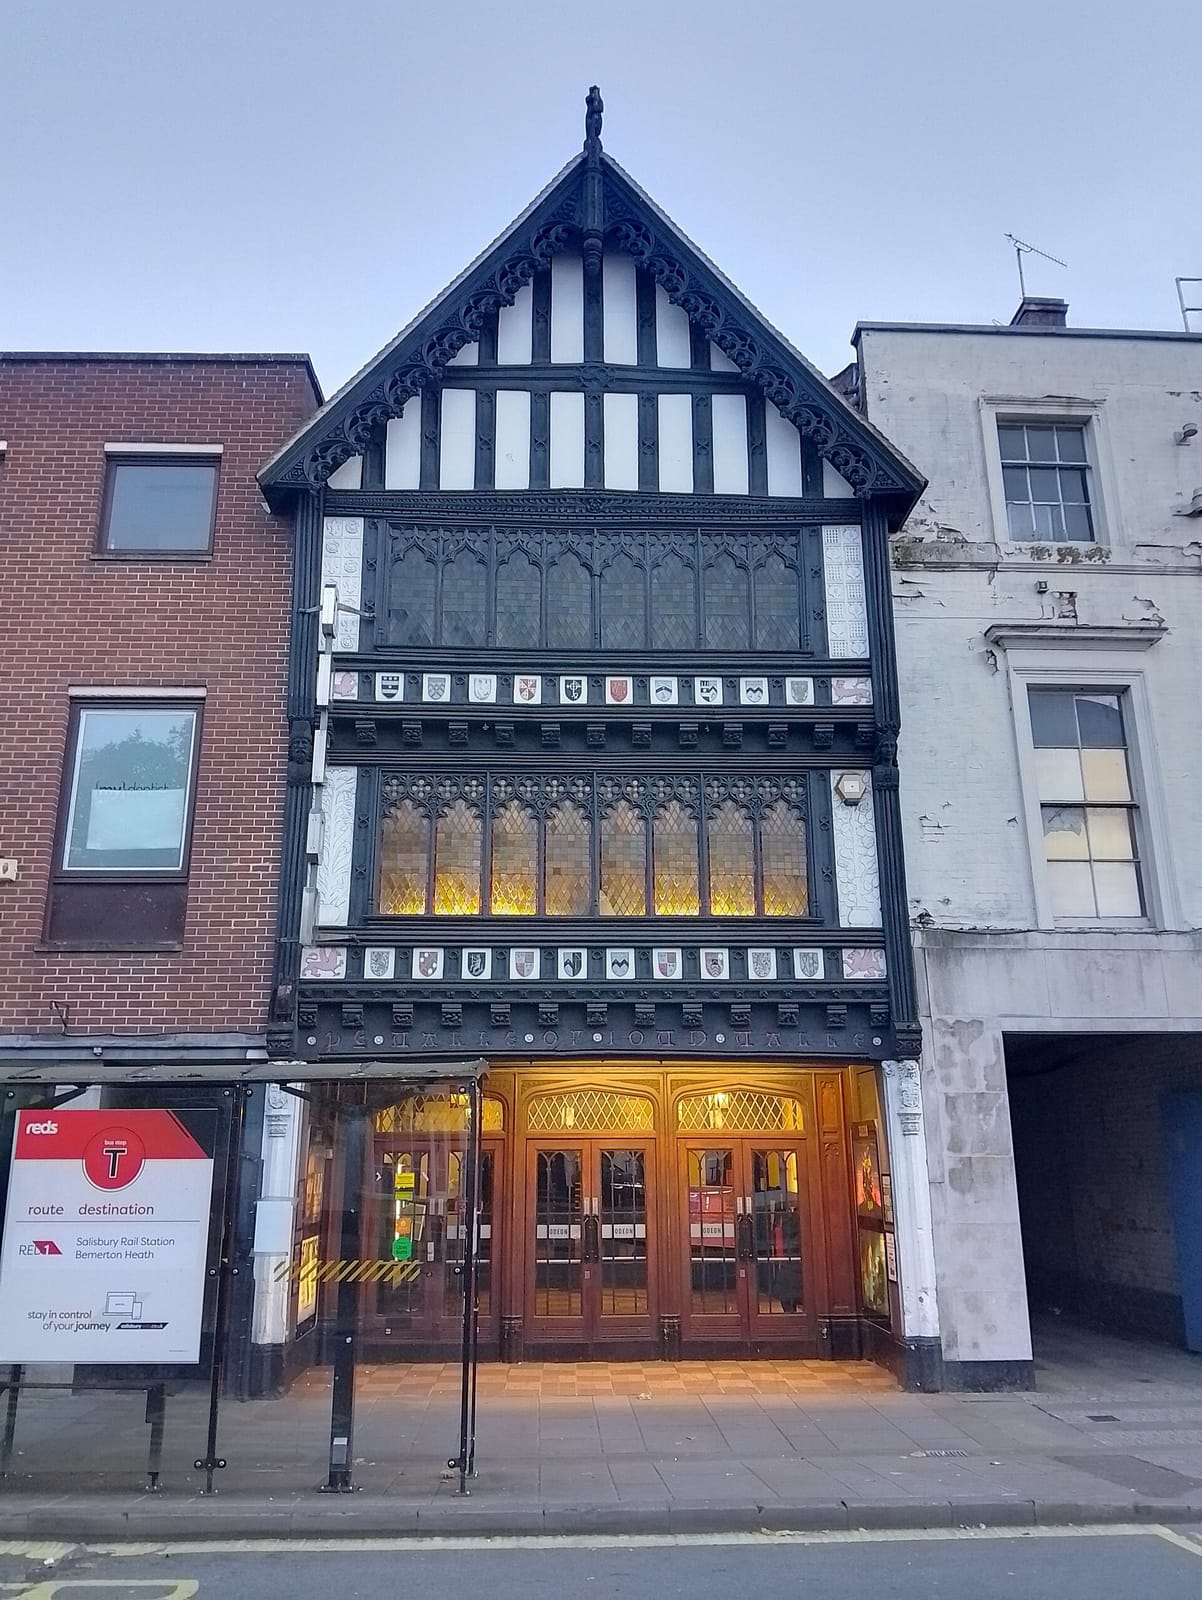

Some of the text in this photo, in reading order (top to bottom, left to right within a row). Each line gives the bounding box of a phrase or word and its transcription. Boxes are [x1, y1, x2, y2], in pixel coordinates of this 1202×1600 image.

[25, 1120, 59, 1135] reds
[115, 1139, 128, 1147] stop
[103, 1147, 128, 1179] T
[28, 1202, 155, 1216] route destination
[76, 1236, 176, 1248] Salisbury Rail Station
[75, 1249, 155, 1260] Bemerton Heath
[27, 1309, 93, 1321] stay in control
[42, 1321, 54, 1330] of
[53, 1322, 74, 1332] your
[73, 1321, 111, 1333] journey
